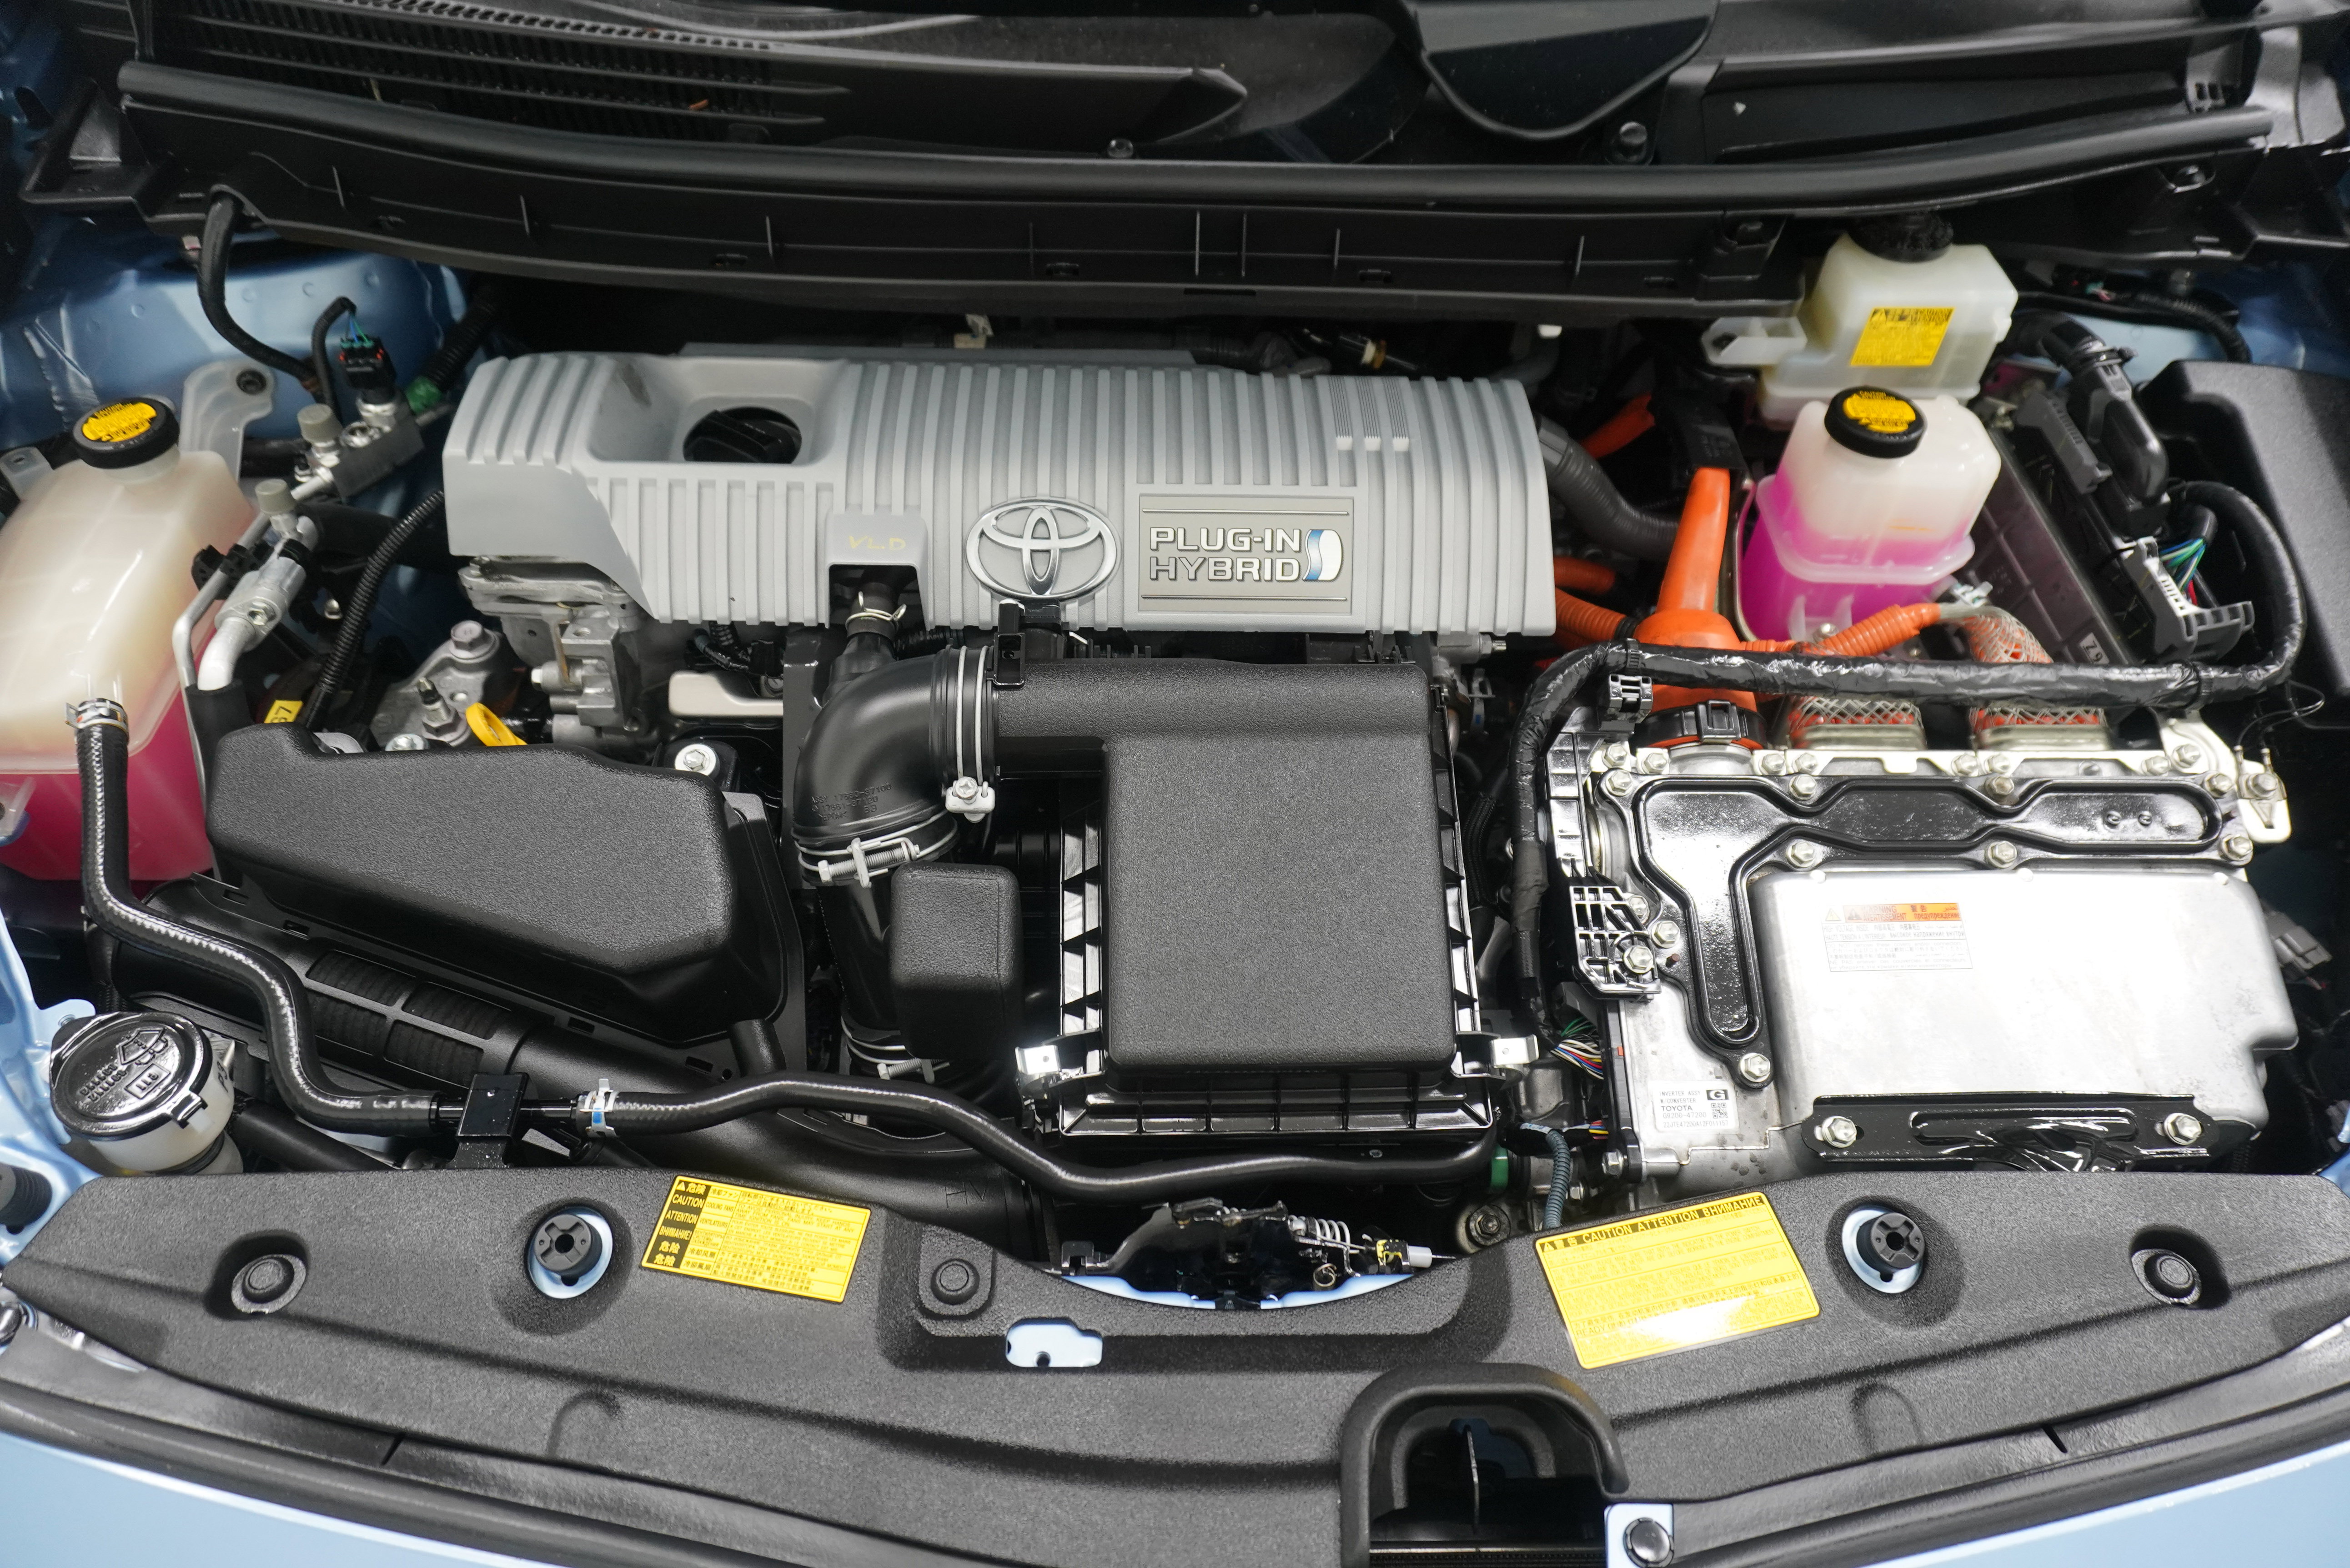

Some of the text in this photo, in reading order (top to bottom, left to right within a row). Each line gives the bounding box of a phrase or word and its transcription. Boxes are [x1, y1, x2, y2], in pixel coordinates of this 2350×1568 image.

[1150, 527, 1301, 552] PLUG-IN
[1150, 557, 1300, 582] HYBRID
[673, 1194, 705, 1208] CAUTION
[1703, 1196, 1763, 1217] ВНИМАНИЕ
[666, 1210, 698, 1224] ATTENTION
[699, 1218, 728, 1228] VENTILATEURS
[659, 1226, 693, 1241] ВНИМАНИЕ!
[1582, 1210, 1699, 1243] CAUTION ATTENTION
[1576, 1325, 1607, 1337] READY
